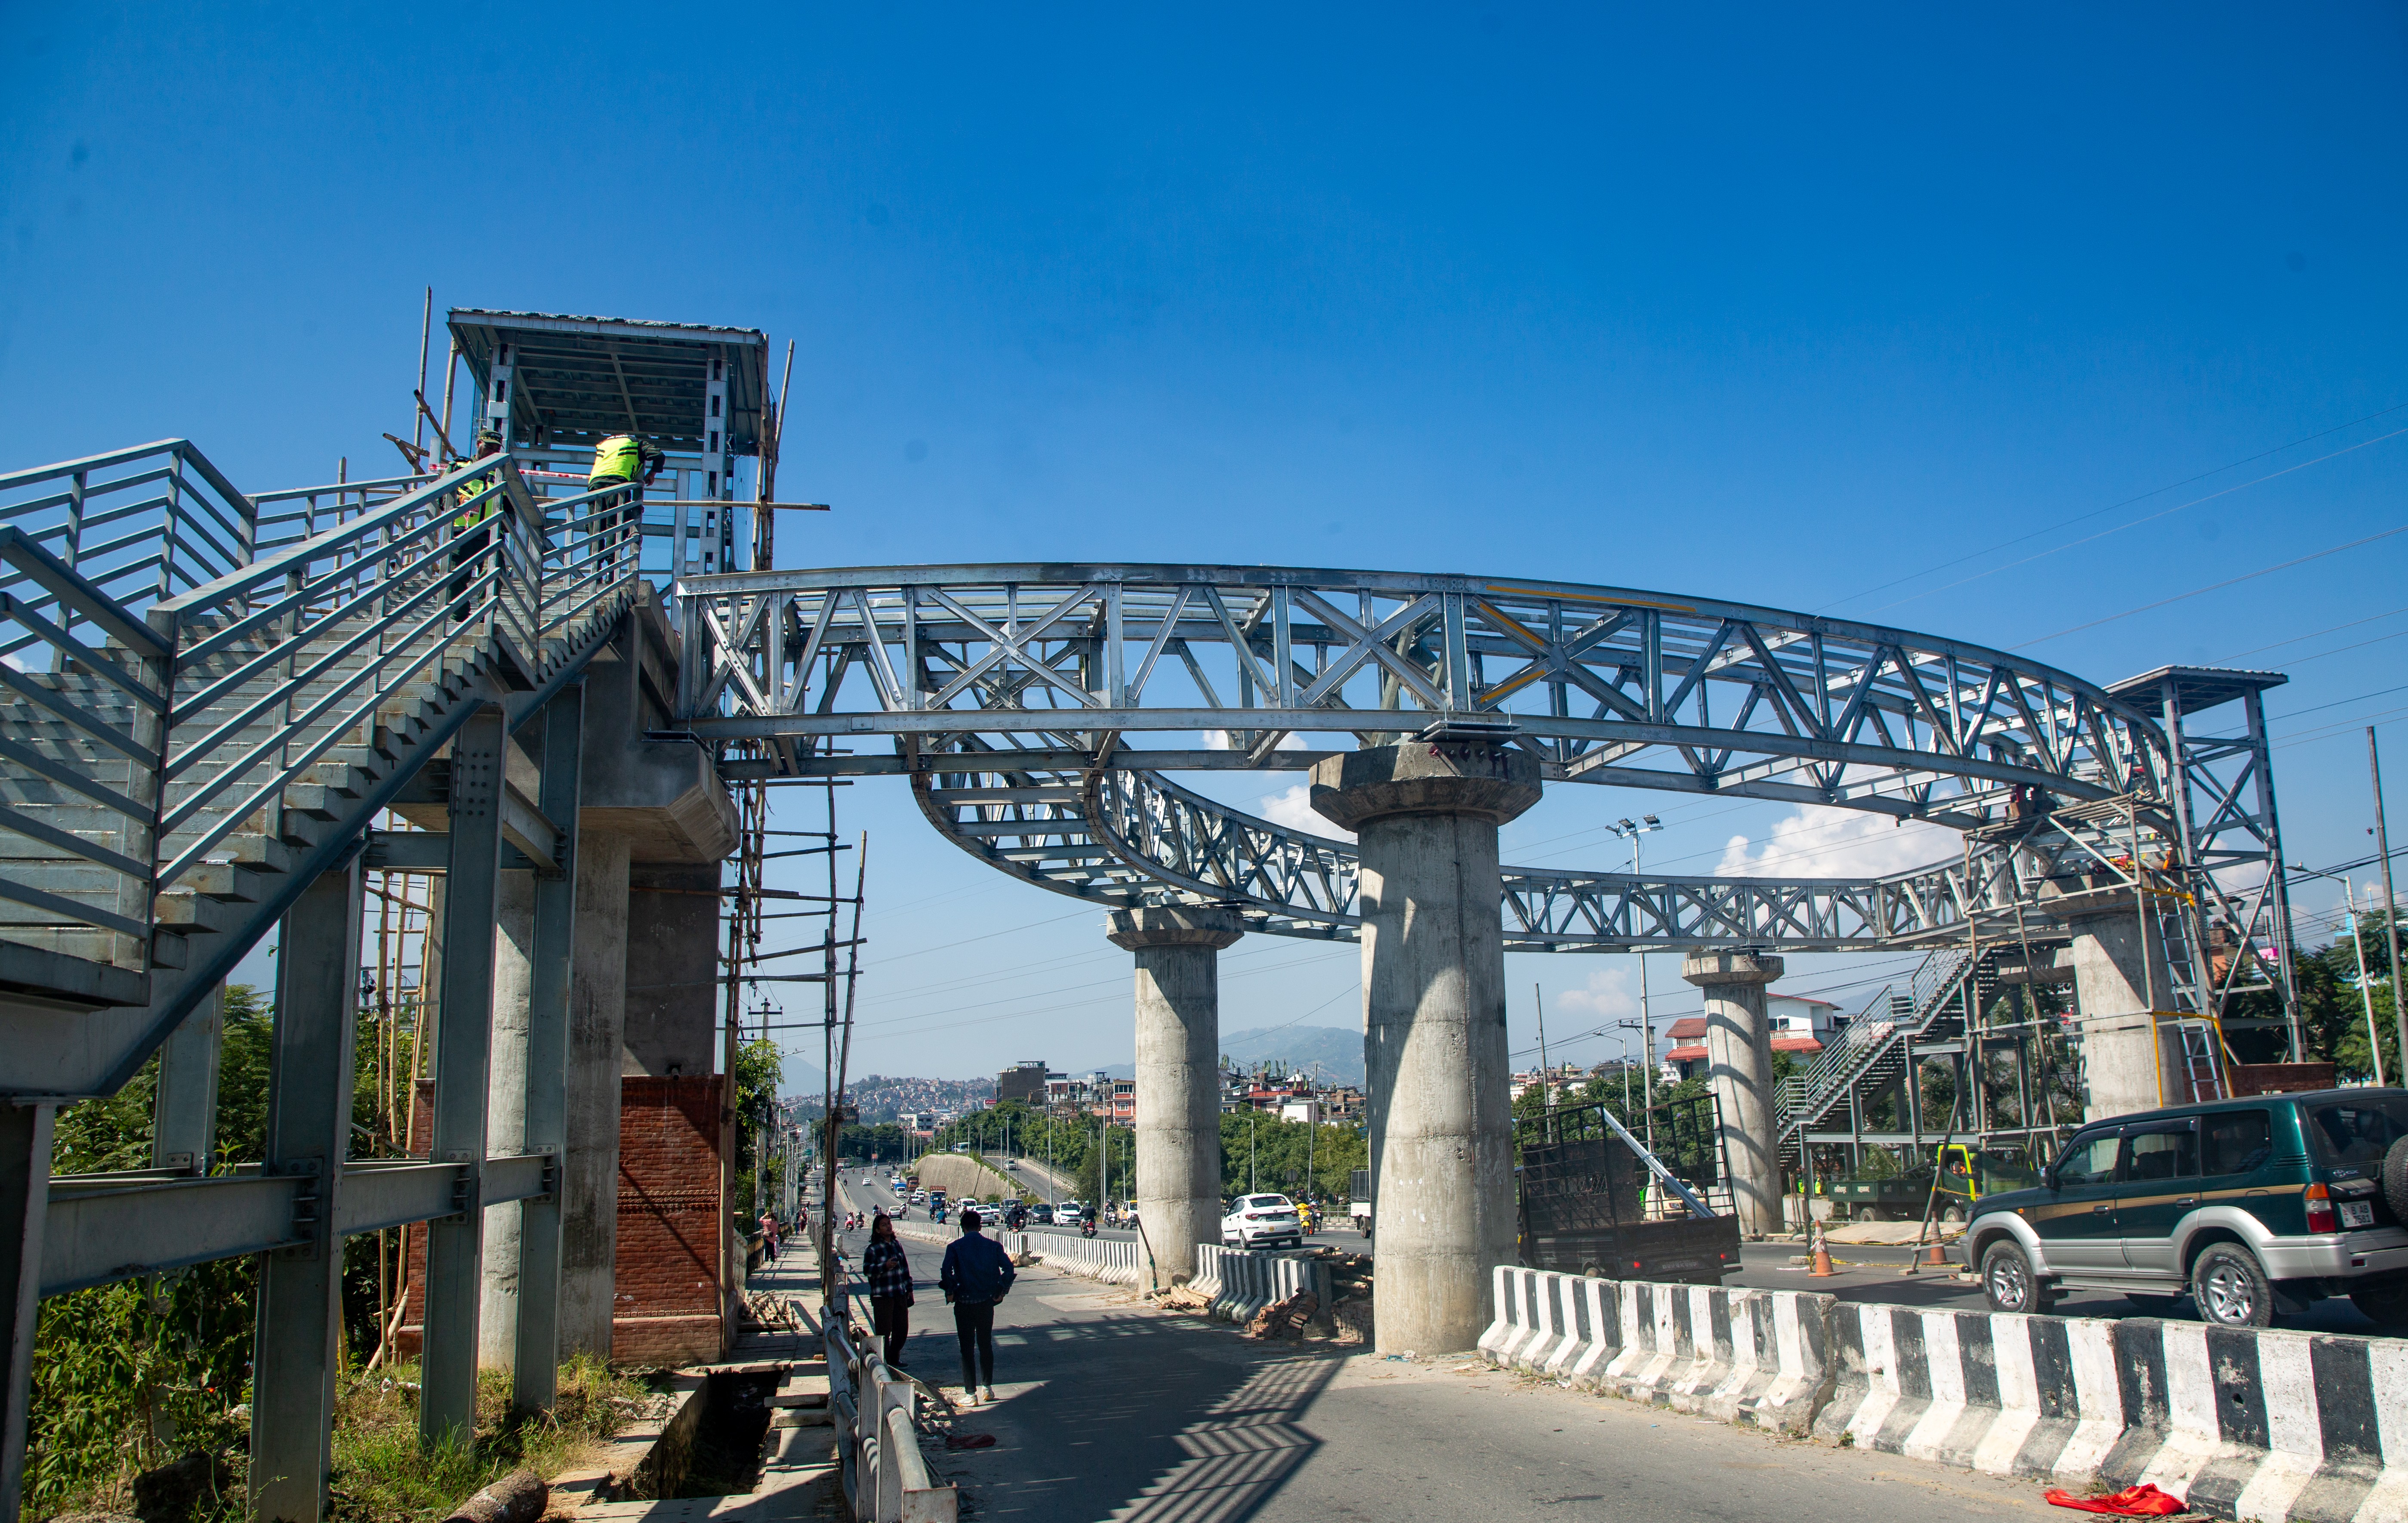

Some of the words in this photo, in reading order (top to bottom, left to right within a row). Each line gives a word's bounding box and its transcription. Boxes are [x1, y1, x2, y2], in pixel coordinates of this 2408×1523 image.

[2351, 1206, 2356, 1214] B
[2359, 1205, 2369, 1213] AB
[2353, 1214, 2371, 1223] 7581
